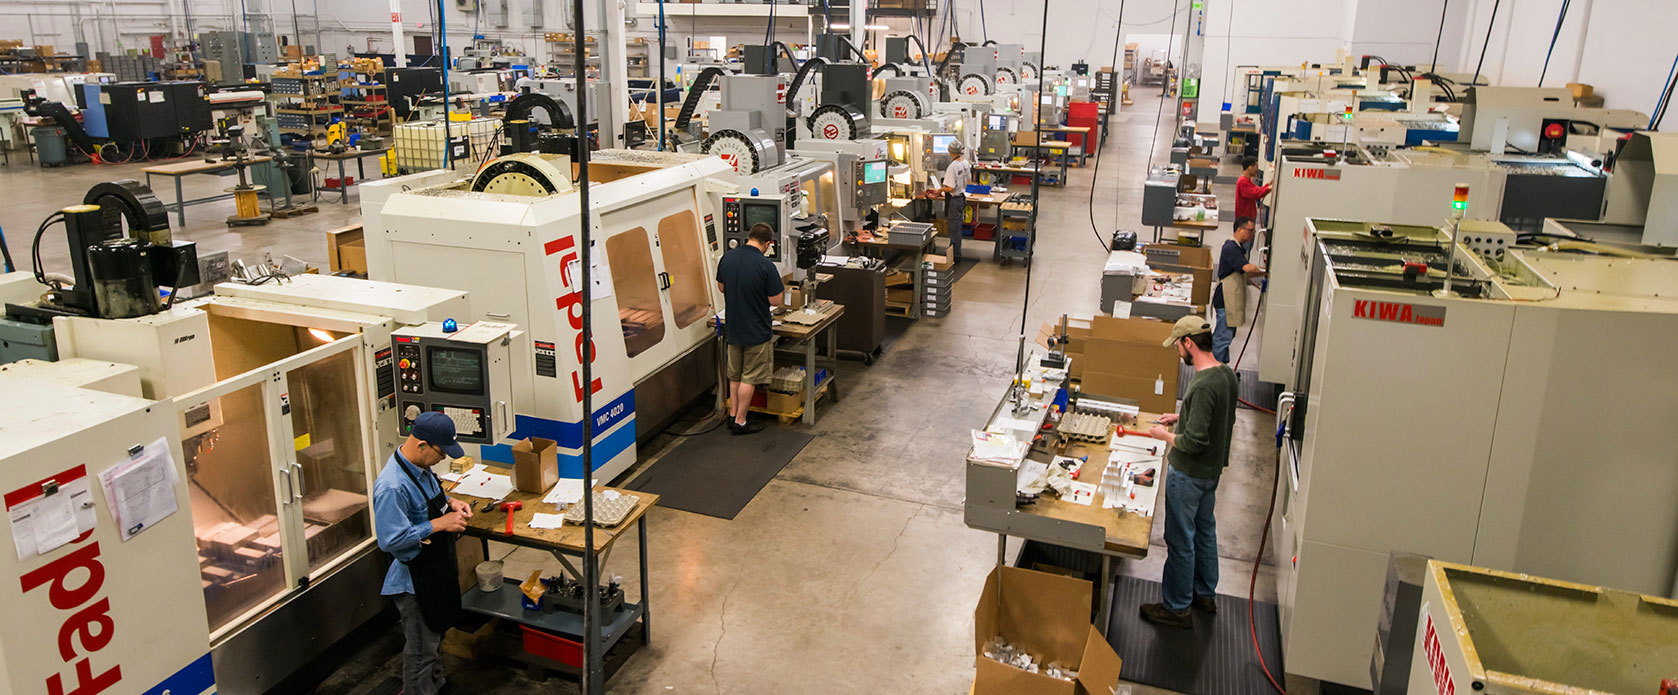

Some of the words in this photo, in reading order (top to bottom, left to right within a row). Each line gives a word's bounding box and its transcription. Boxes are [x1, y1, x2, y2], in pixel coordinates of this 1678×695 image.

[1293, 167, 1325, 180] KIWA
[1354, 299, 1413, 324] KIWA
[597, 411, 610, 427] VMC
[4, 463, 122, 695] Fadl
